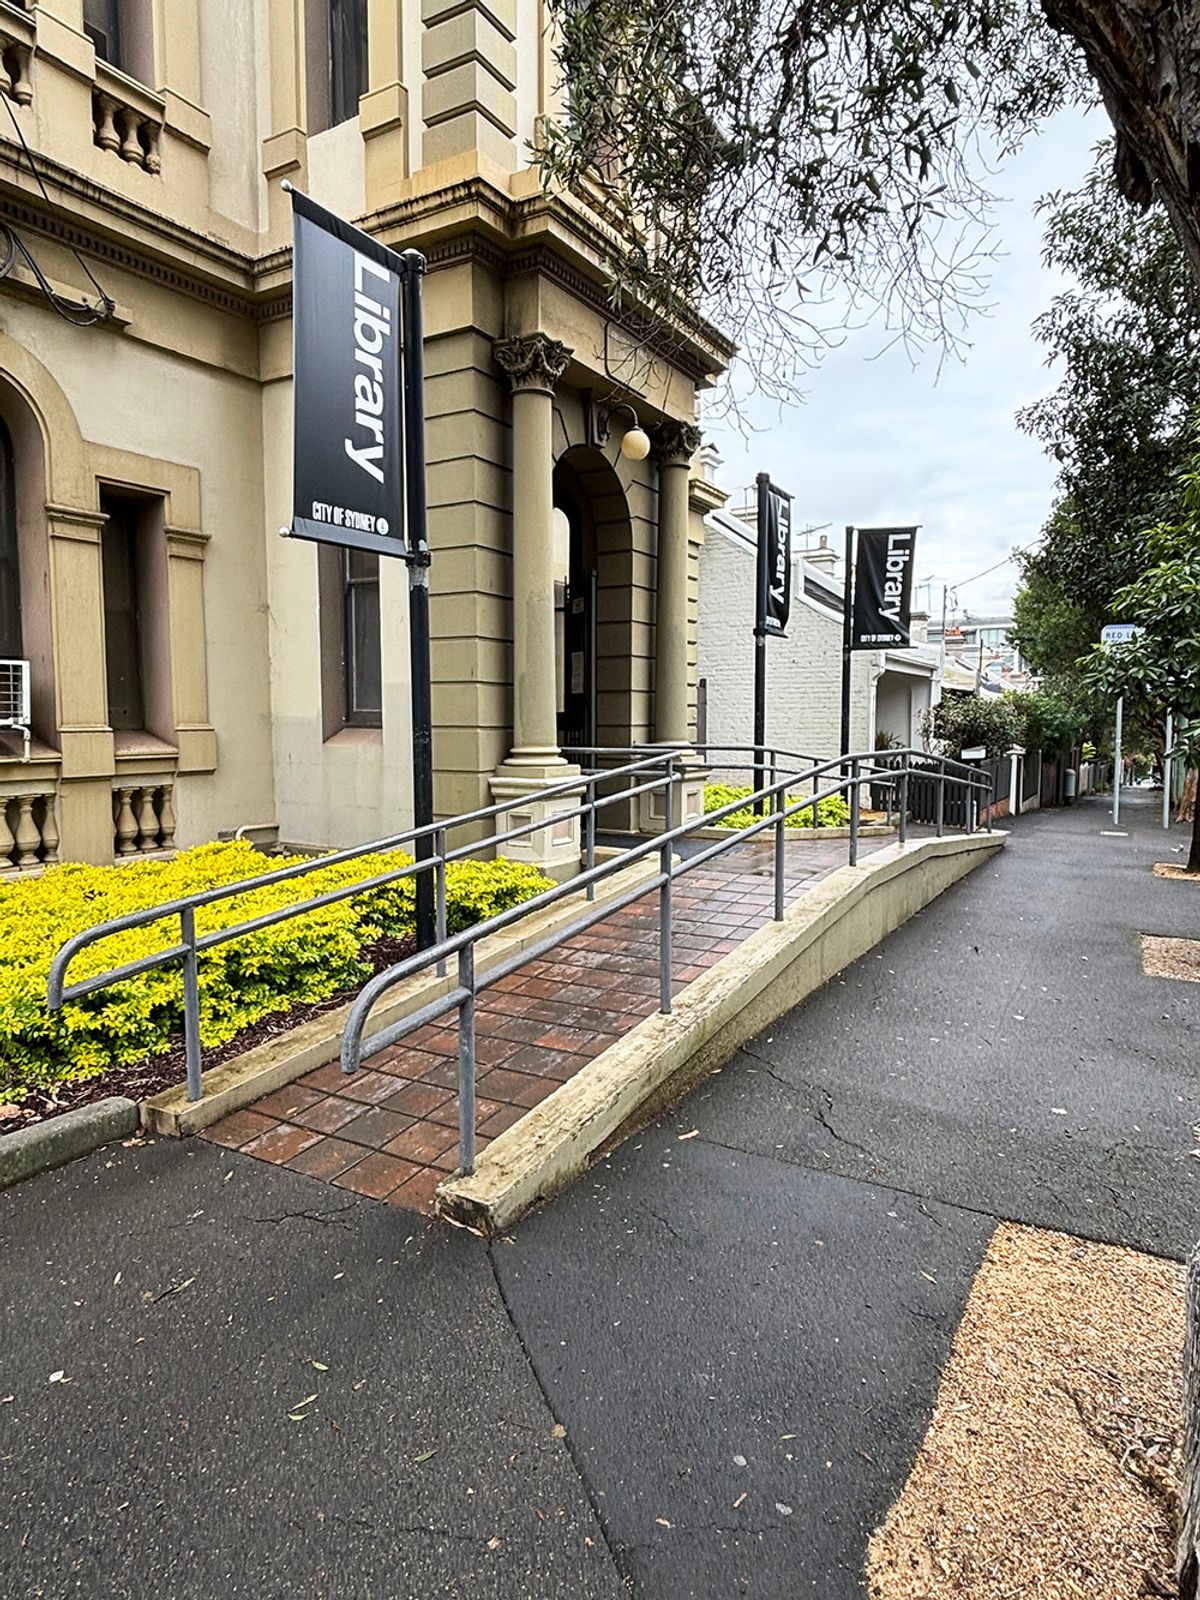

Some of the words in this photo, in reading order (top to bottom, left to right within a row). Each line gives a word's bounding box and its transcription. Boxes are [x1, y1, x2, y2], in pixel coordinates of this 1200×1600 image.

[345, 250, 391, 483] Library
[312, 501, 333, 523] CITY
[333, 506, 344, 526] OF
[344, 509, 376, 533] SYDNEY
[769, 499, 788, 604] Library
[879, 533, 911, 622] Library
